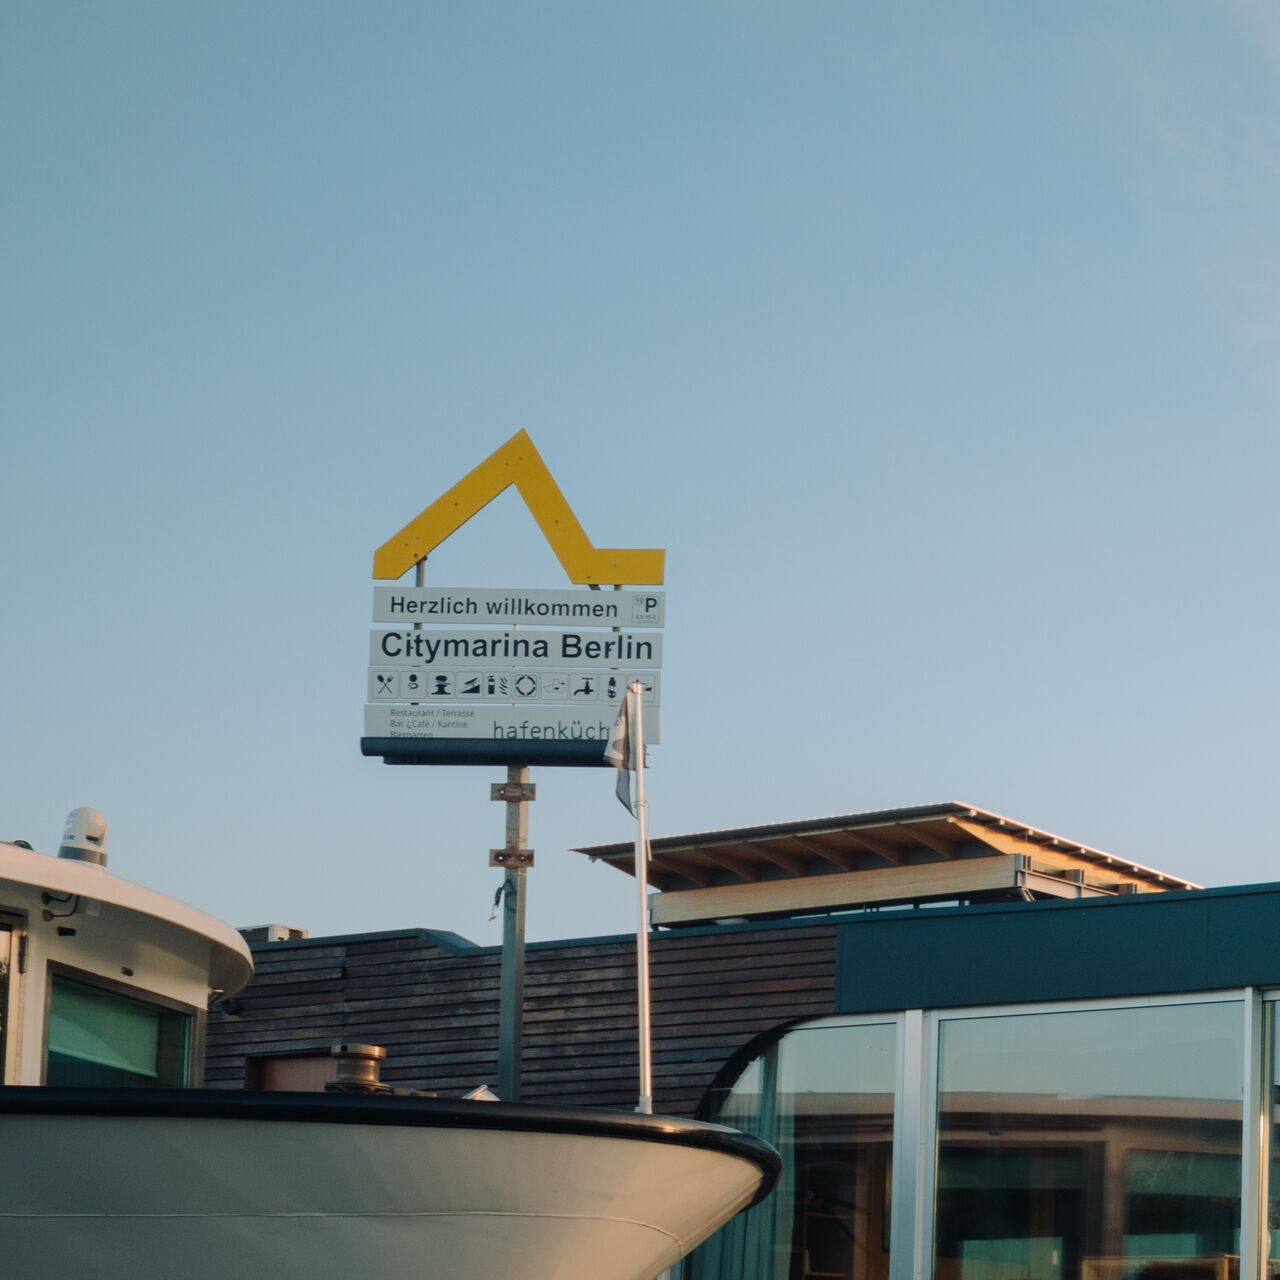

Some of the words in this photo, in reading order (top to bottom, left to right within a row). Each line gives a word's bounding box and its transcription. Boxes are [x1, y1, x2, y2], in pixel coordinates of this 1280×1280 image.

[390, 596, 478, 614] Herzlich
[486, 598, 618, 618] willkommen
[645, 597, 658, 613] P
[381, 632, 549, 664] Citymarina
[561, 633, 653, 660] Berlin
[390, 708, 434, 717] Restaurant
[441, 709, 475, 718] Terrasse
[390, 720, 404, 728] Bar
[437, 720, 468, 729] Kantine
